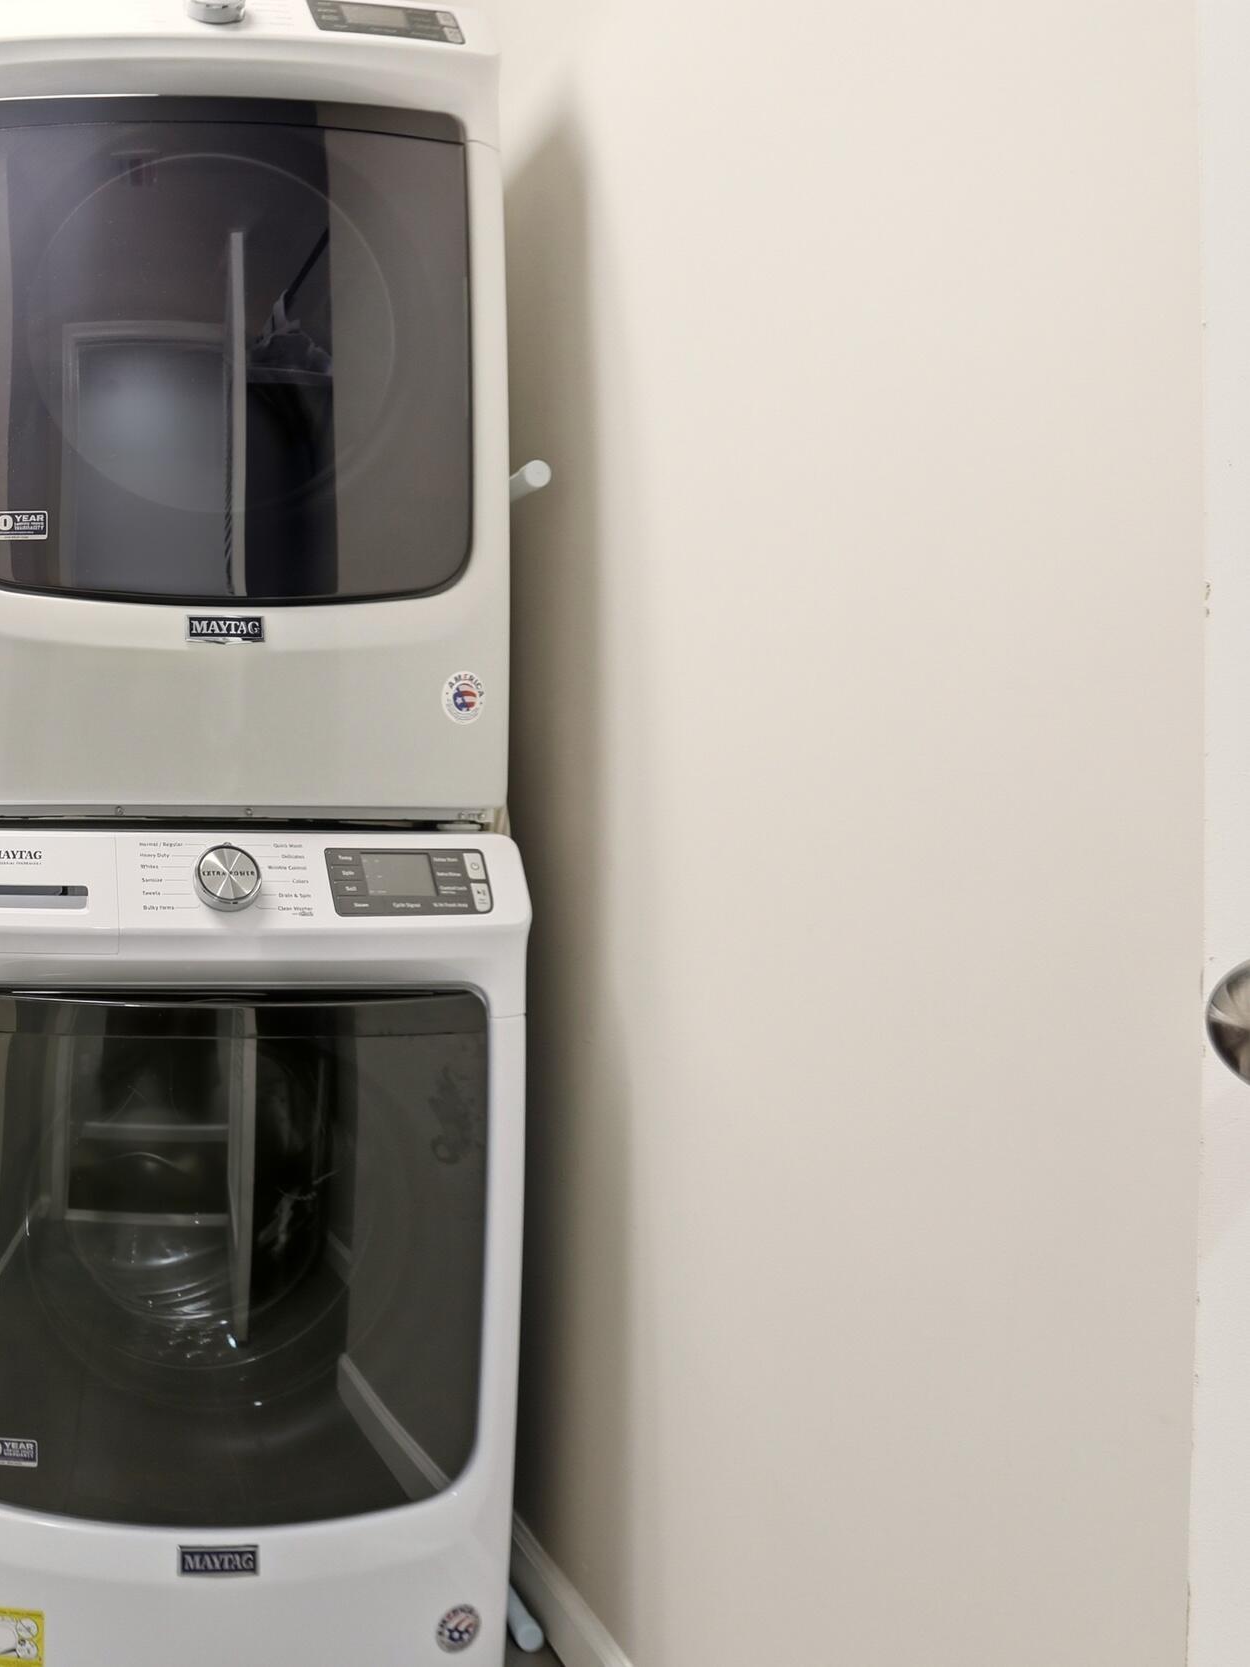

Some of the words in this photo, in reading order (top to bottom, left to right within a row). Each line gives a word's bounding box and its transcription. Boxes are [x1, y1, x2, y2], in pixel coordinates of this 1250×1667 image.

[14, 514, 44, 522] YEAR
[190, 620, 260, 634] MAYTAG
[448, 674, 484, 698] AMERICA
[4, 1442, 34, 1450] YEAR
[184, 1553, 254, 1570] MAYTAG
